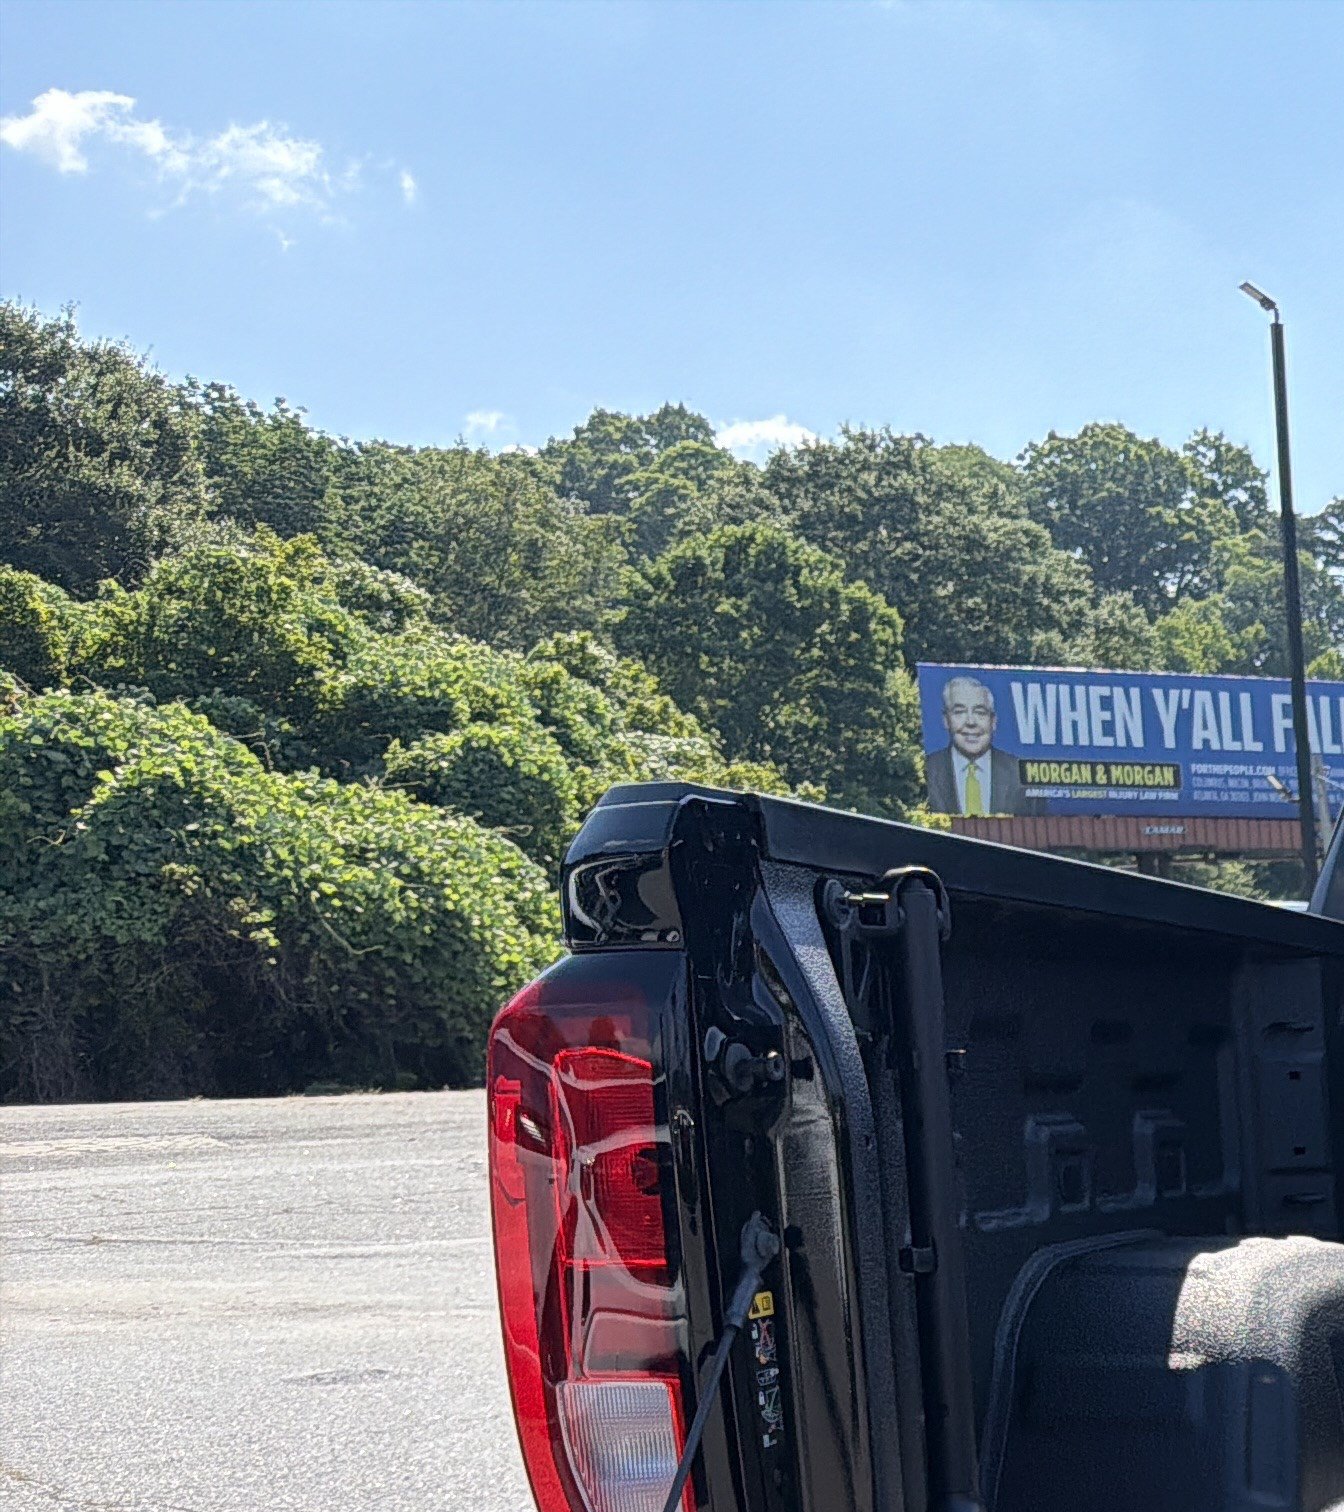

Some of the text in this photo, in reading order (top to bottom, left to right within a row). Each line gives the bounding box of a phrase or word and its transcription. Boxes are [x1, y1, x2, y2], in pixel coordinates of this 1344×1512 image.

[1011, 681, 1144, 748] WHEN
[1152, 688, 1263, 751] Y'ALL
[1025, 762, 1092, 784] MORGAN
[1095, 764, 1108, 785] &
[1110, 764, 1175, 787] MORGAN
